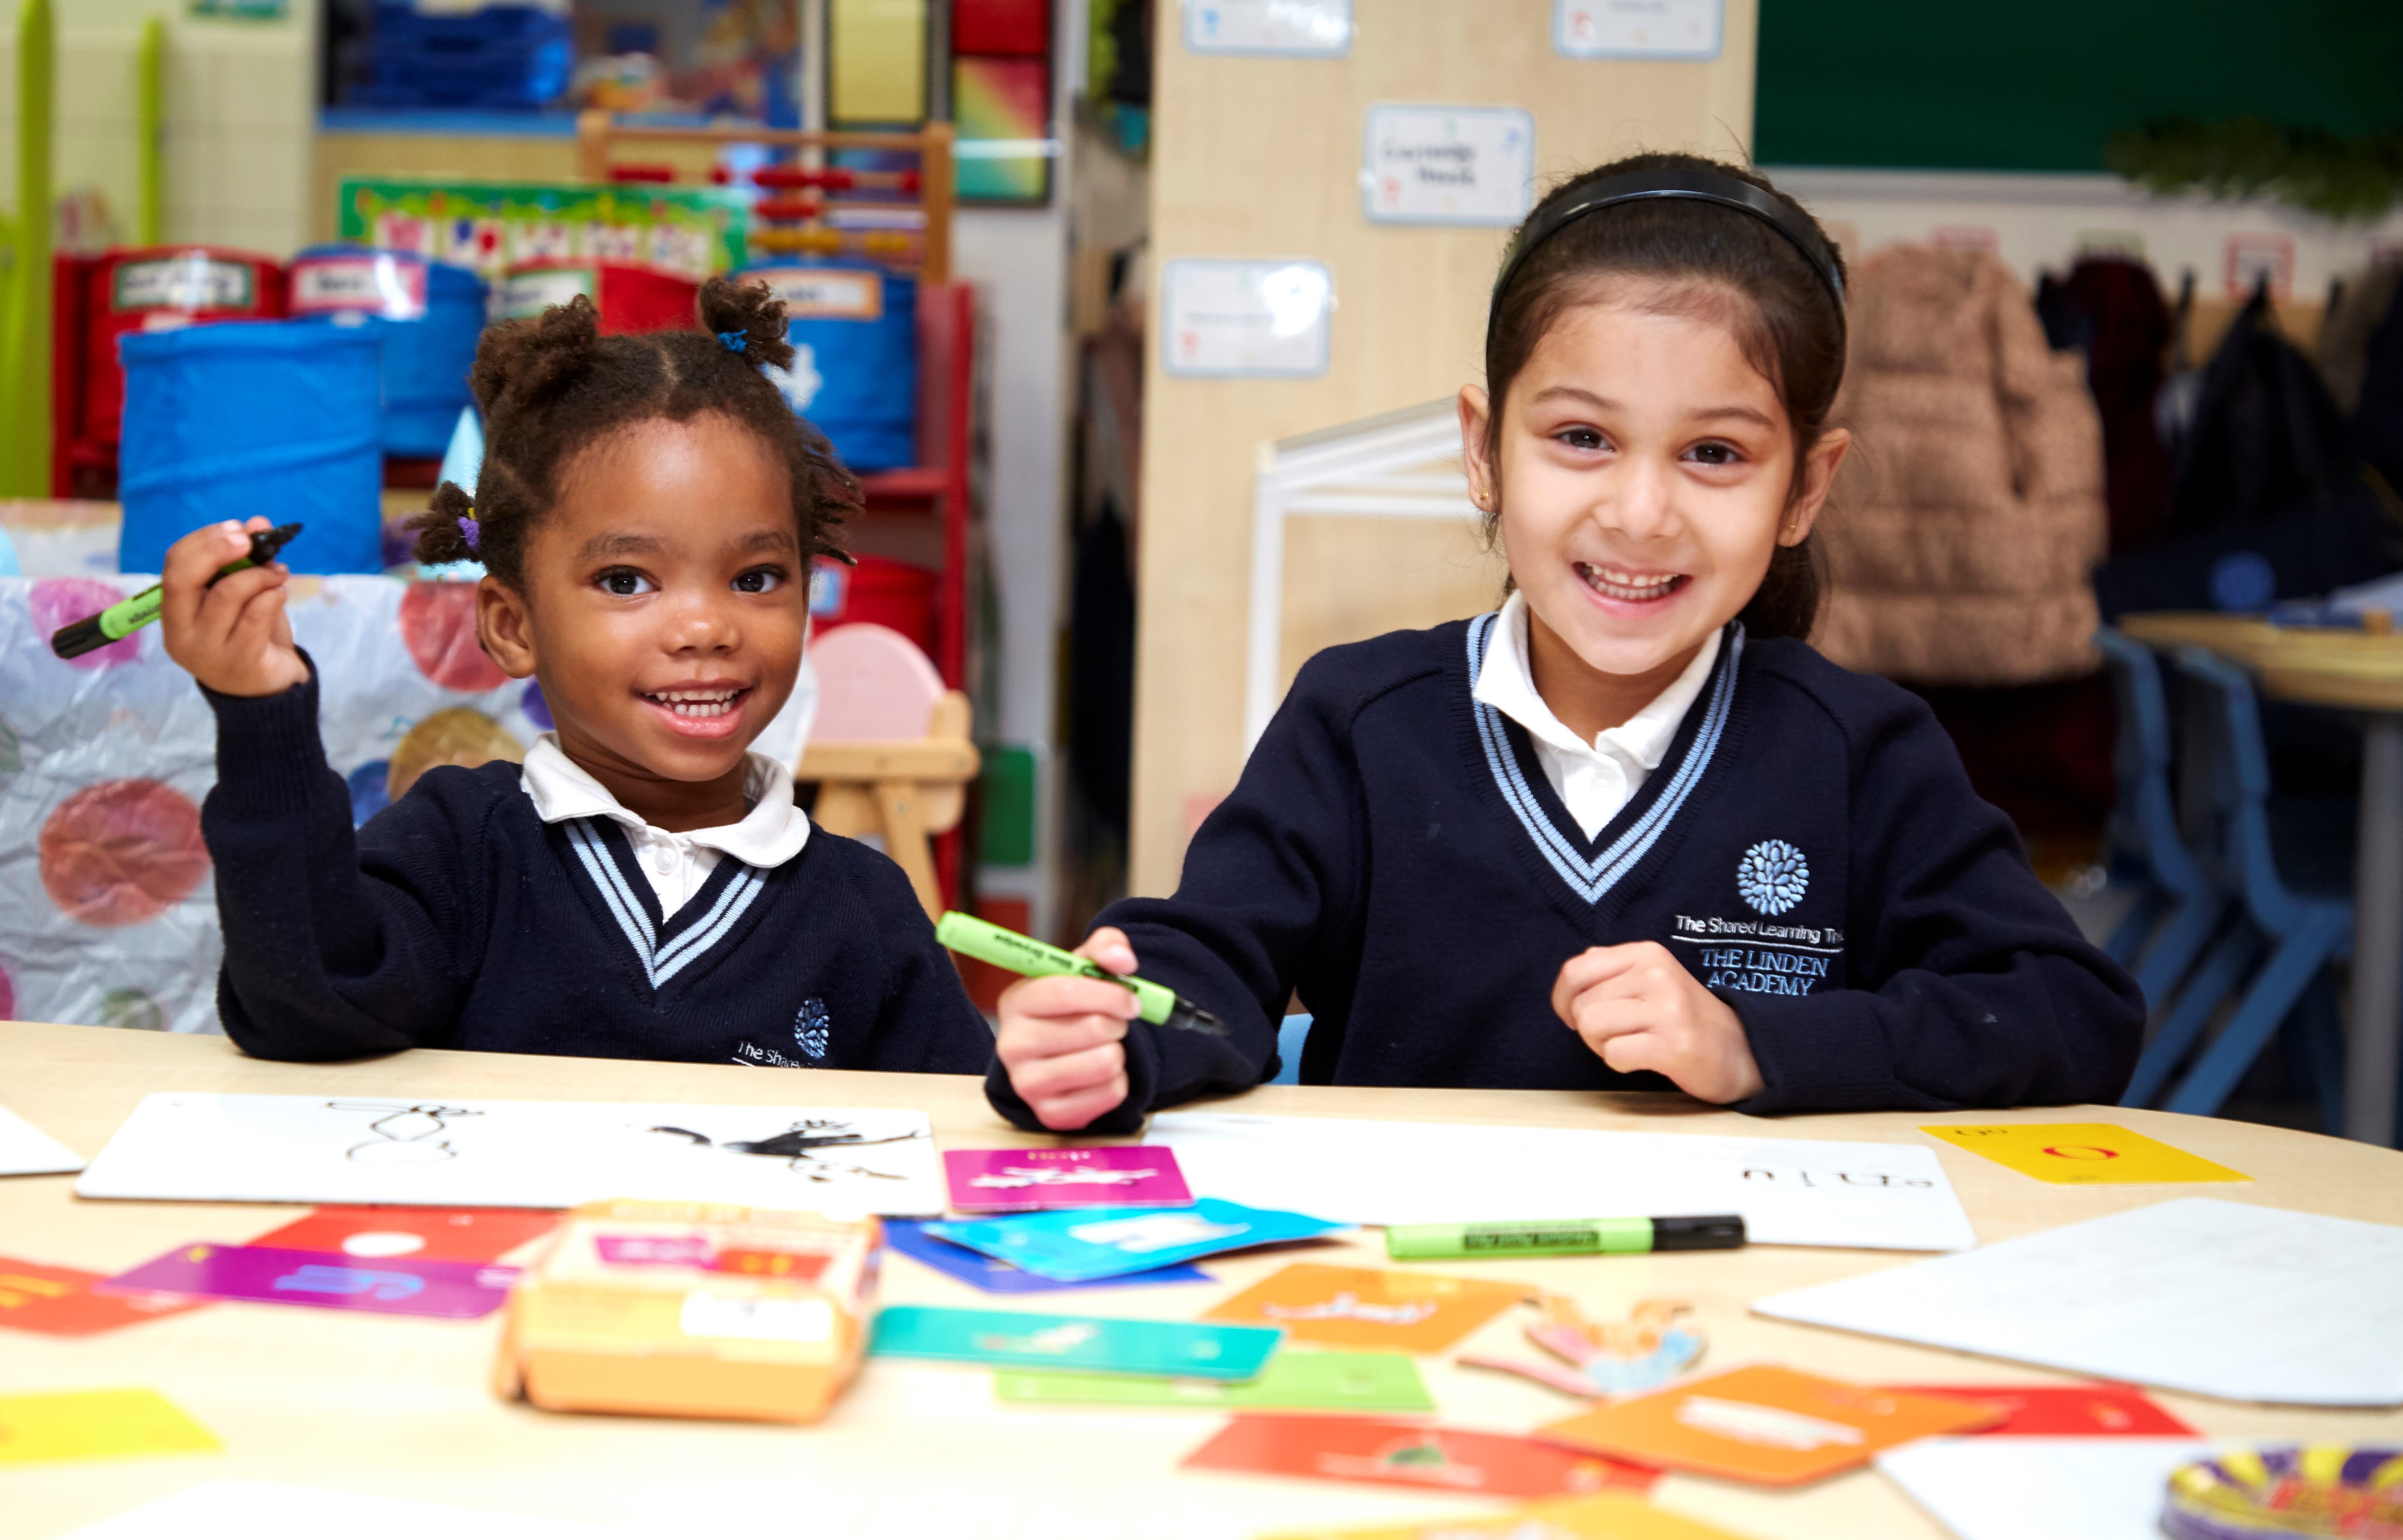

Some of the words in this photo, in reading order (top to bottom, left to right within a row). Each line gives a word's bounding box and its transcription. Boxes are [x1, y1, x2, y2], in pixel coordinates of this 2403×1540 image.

[1676, 914, 1706, 932] The
[1708, 917, 1757, 934] Shared
[1757, 922, 1821, 944] Learning
[1700, 949, 1744, 968] THE
[1745, 950, 1831, 978] LINDEN
[1707, 970, 1816, 996] ACADEMY
[739, 1041, 763, 1060] The
